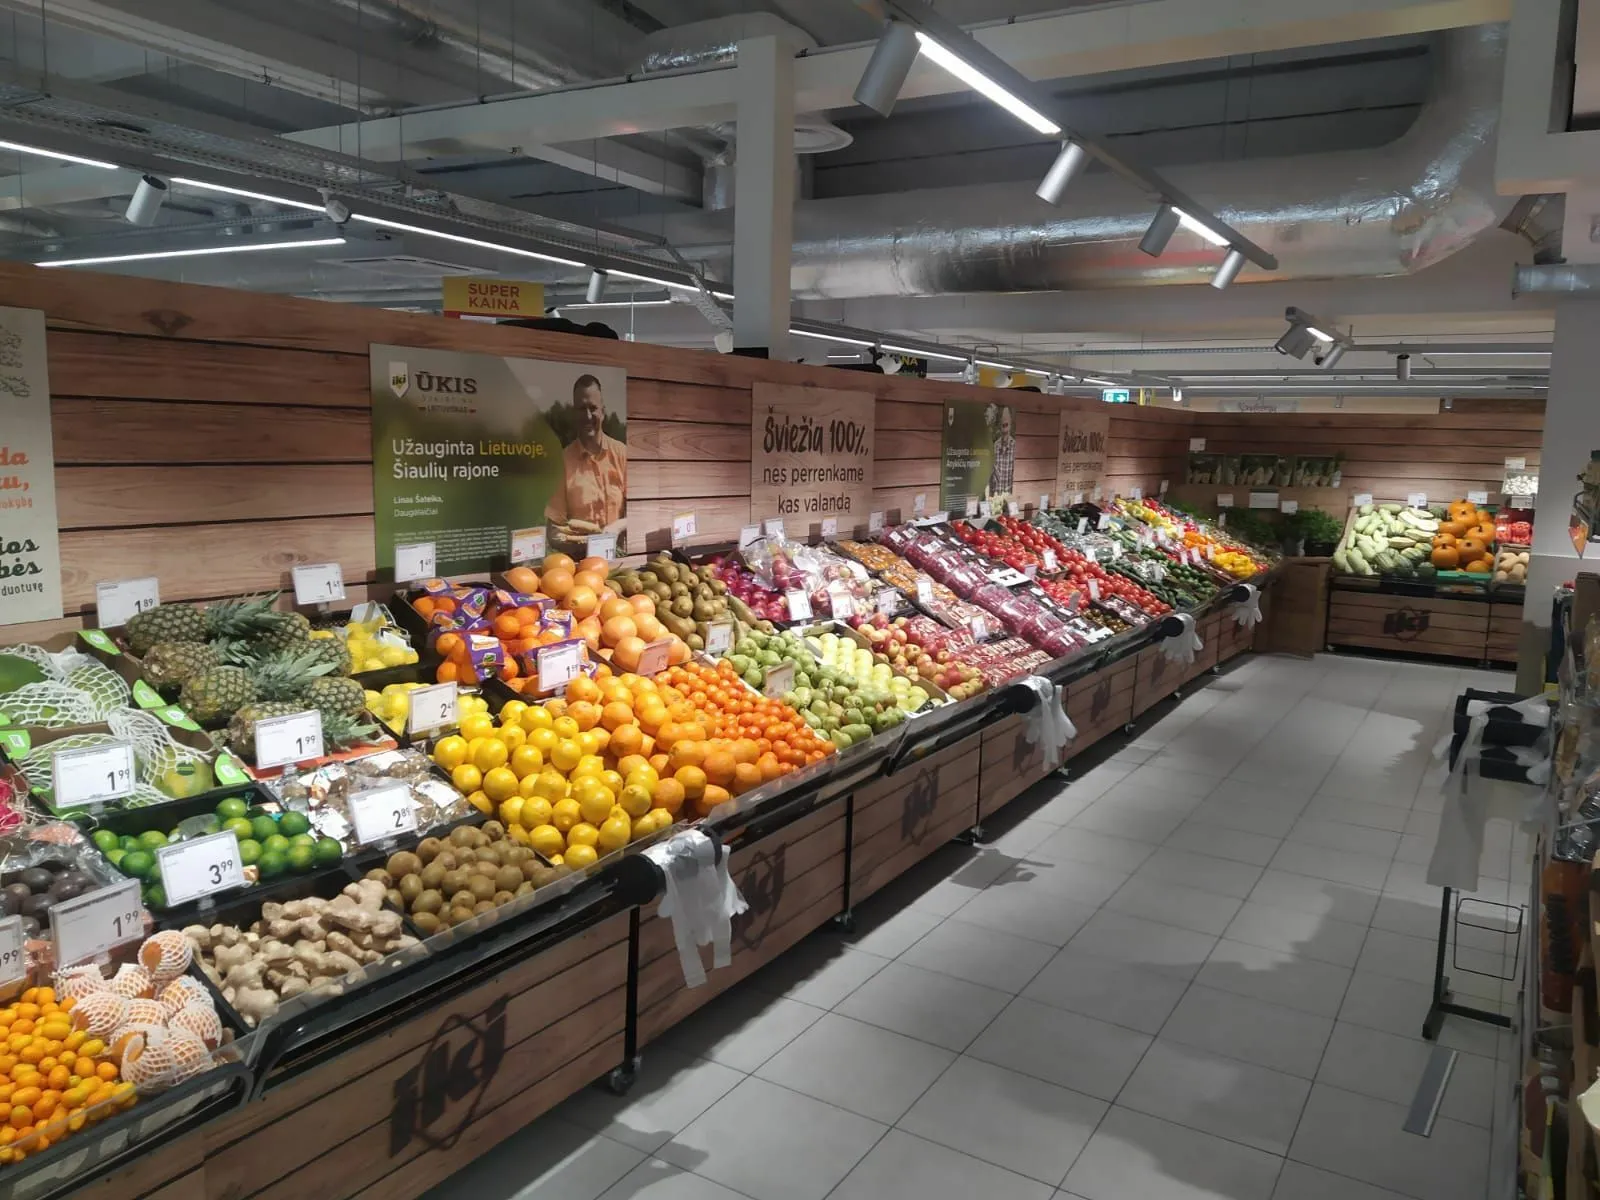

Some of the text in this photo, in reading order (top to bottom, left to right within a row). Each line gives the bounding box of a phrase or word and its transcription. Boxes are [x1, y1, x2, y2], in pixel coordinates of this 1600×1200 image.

[468, 283, 519, 298] SUPER
[468, 297, 520, 310] KAINA
[414, 371, 478, 394] ŪKIS
[392, 438, 475, 458] Užauginta
[393, 458, 499, 480] Šiaulių rajone
[763, 464, 864, 486] nes perrenkame
[778, 492, 851, 514] kas valandą
